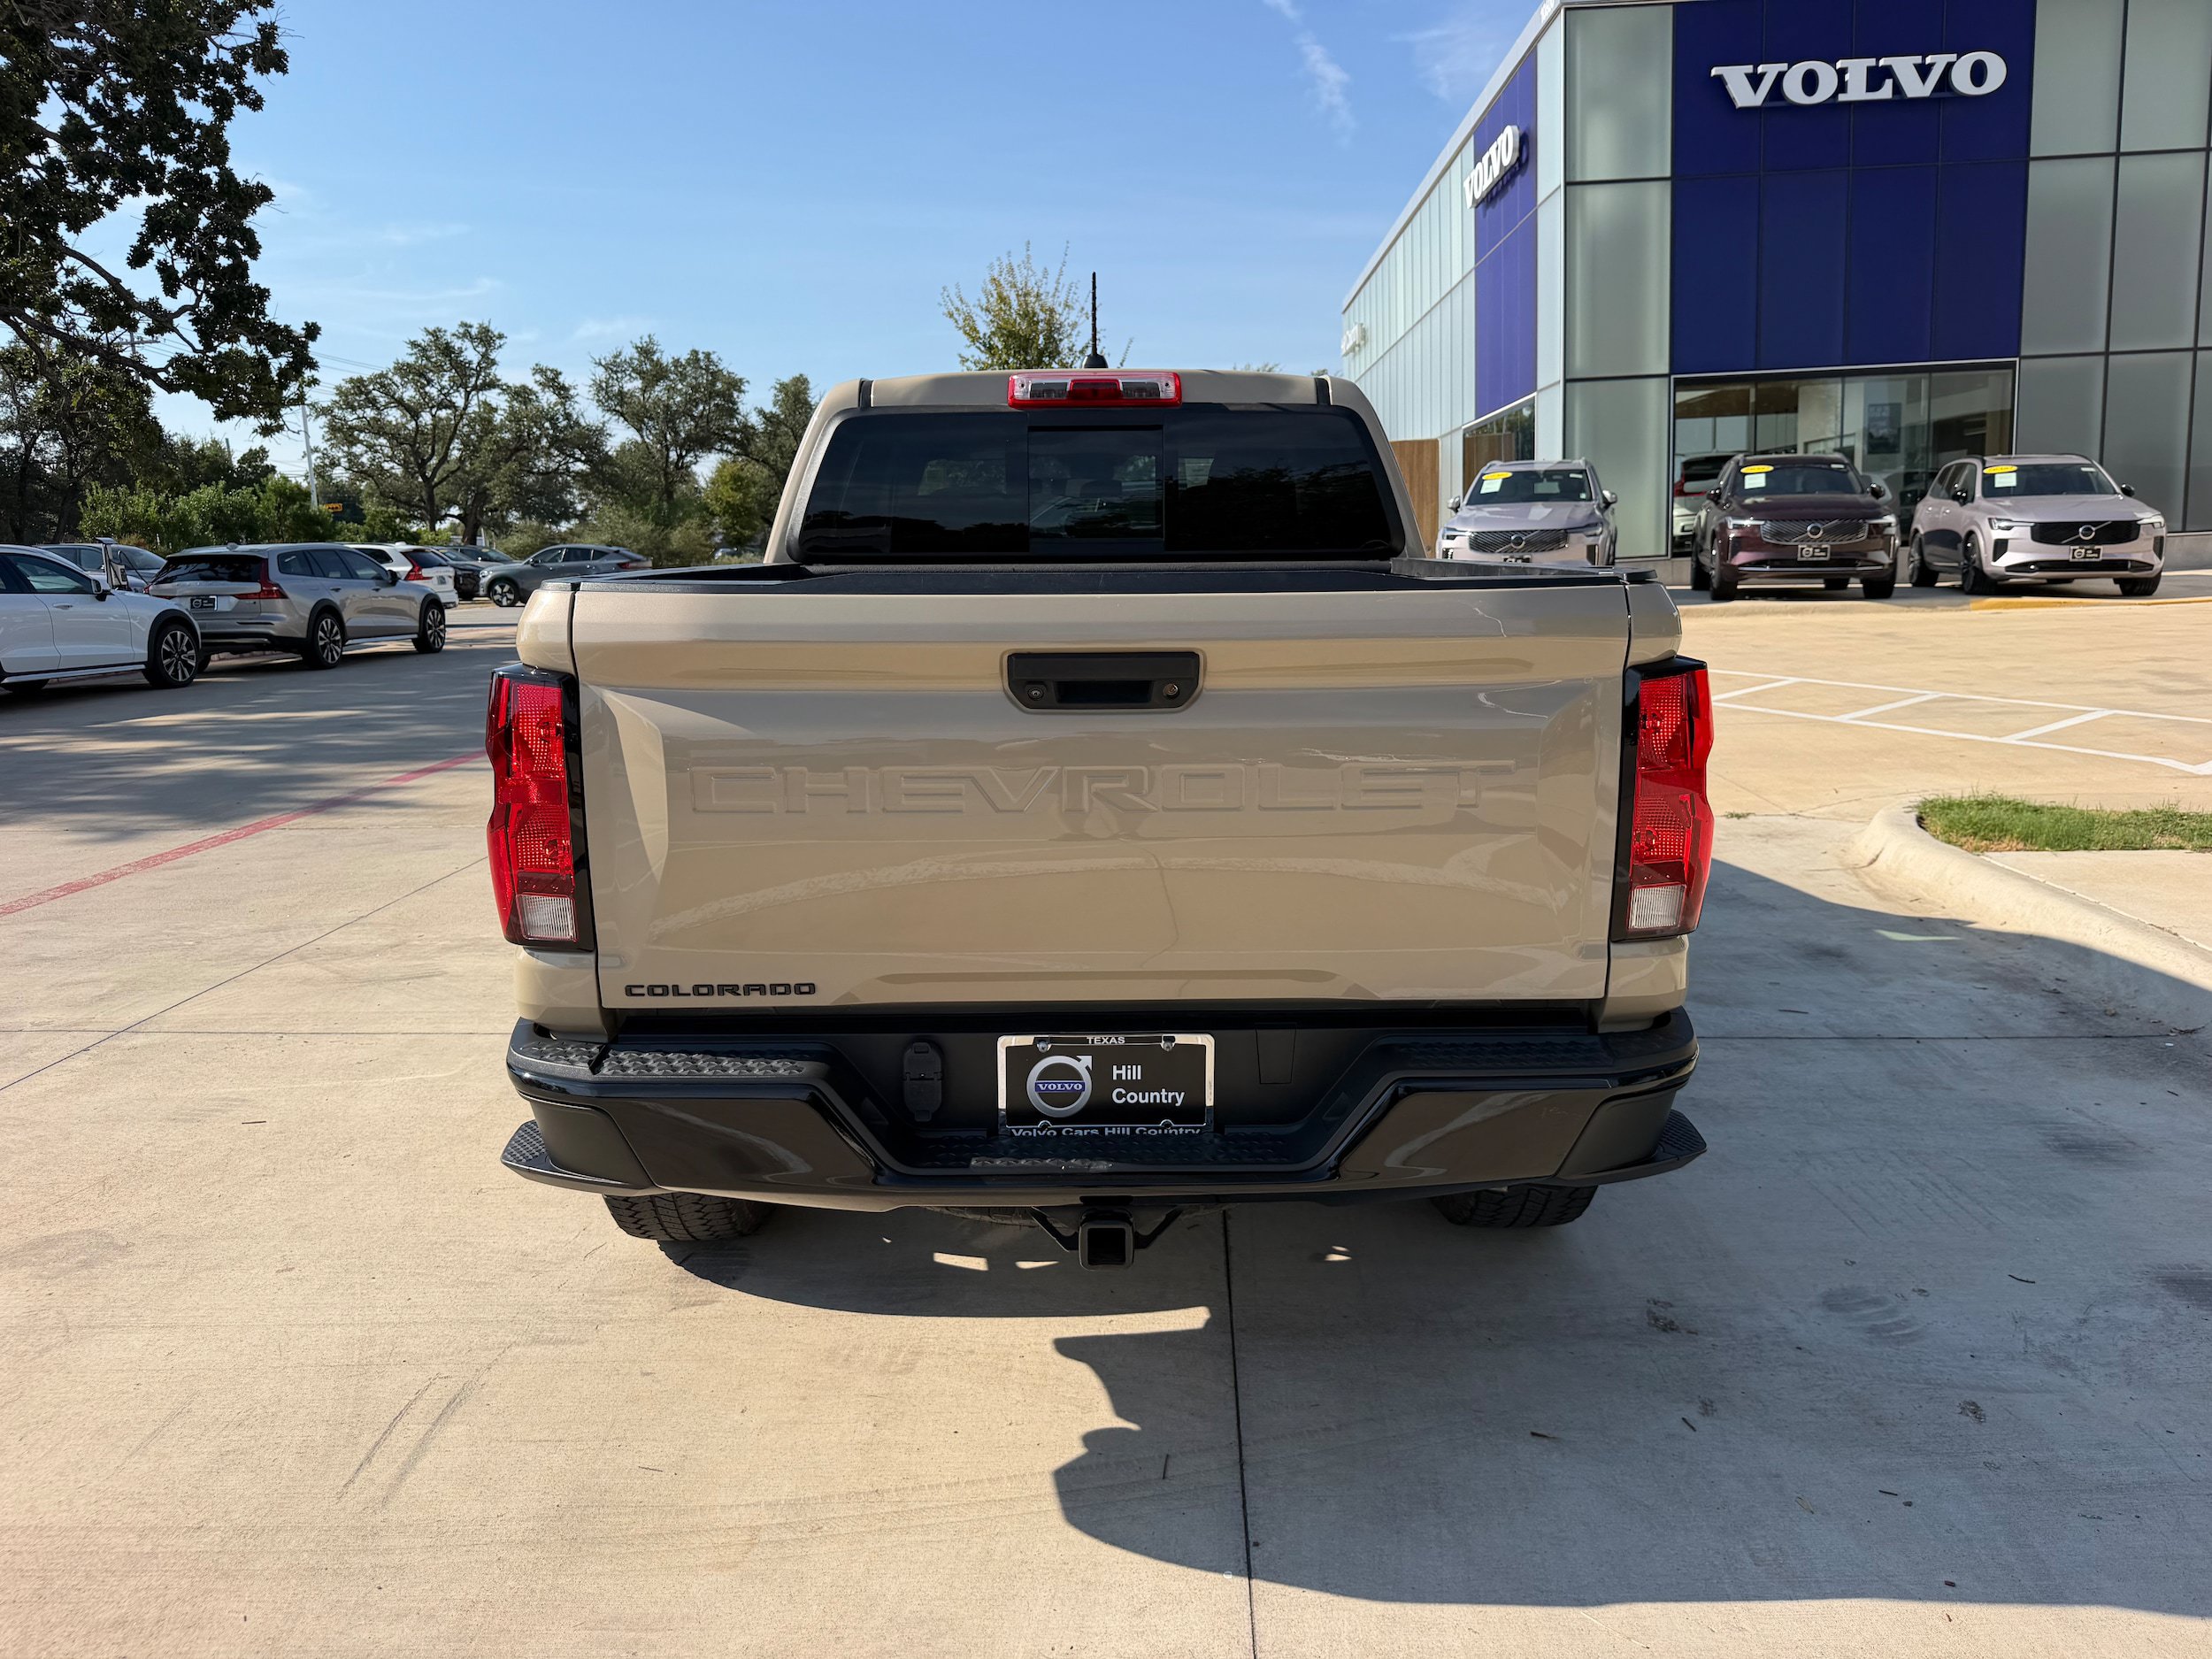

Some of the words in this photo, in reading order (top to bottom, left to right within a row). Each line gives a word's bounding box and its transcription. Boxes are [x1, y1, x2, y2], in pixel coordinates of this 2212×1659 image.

[1710, 50, 2008, 109] VOLVO
[1463, 125, 1519, 210] VOLVO
[689, 760, 1518, 813] CHEVROLET
[625, 982, 816, 997] COLORADO
[1087, 1036, 1125, 1045] TEXAS
[1112, 1064, 1142, 1081] Hill
[1037, 1082, 1083, 1092] VOLVO
[1111, 1087, 1186, 1107] Country
[1011, 1128, 1057, 1137] Volvo
[1062, 1127, 1100, 1136] Cars
[1104, 1126, 1131, 1136] Hill
